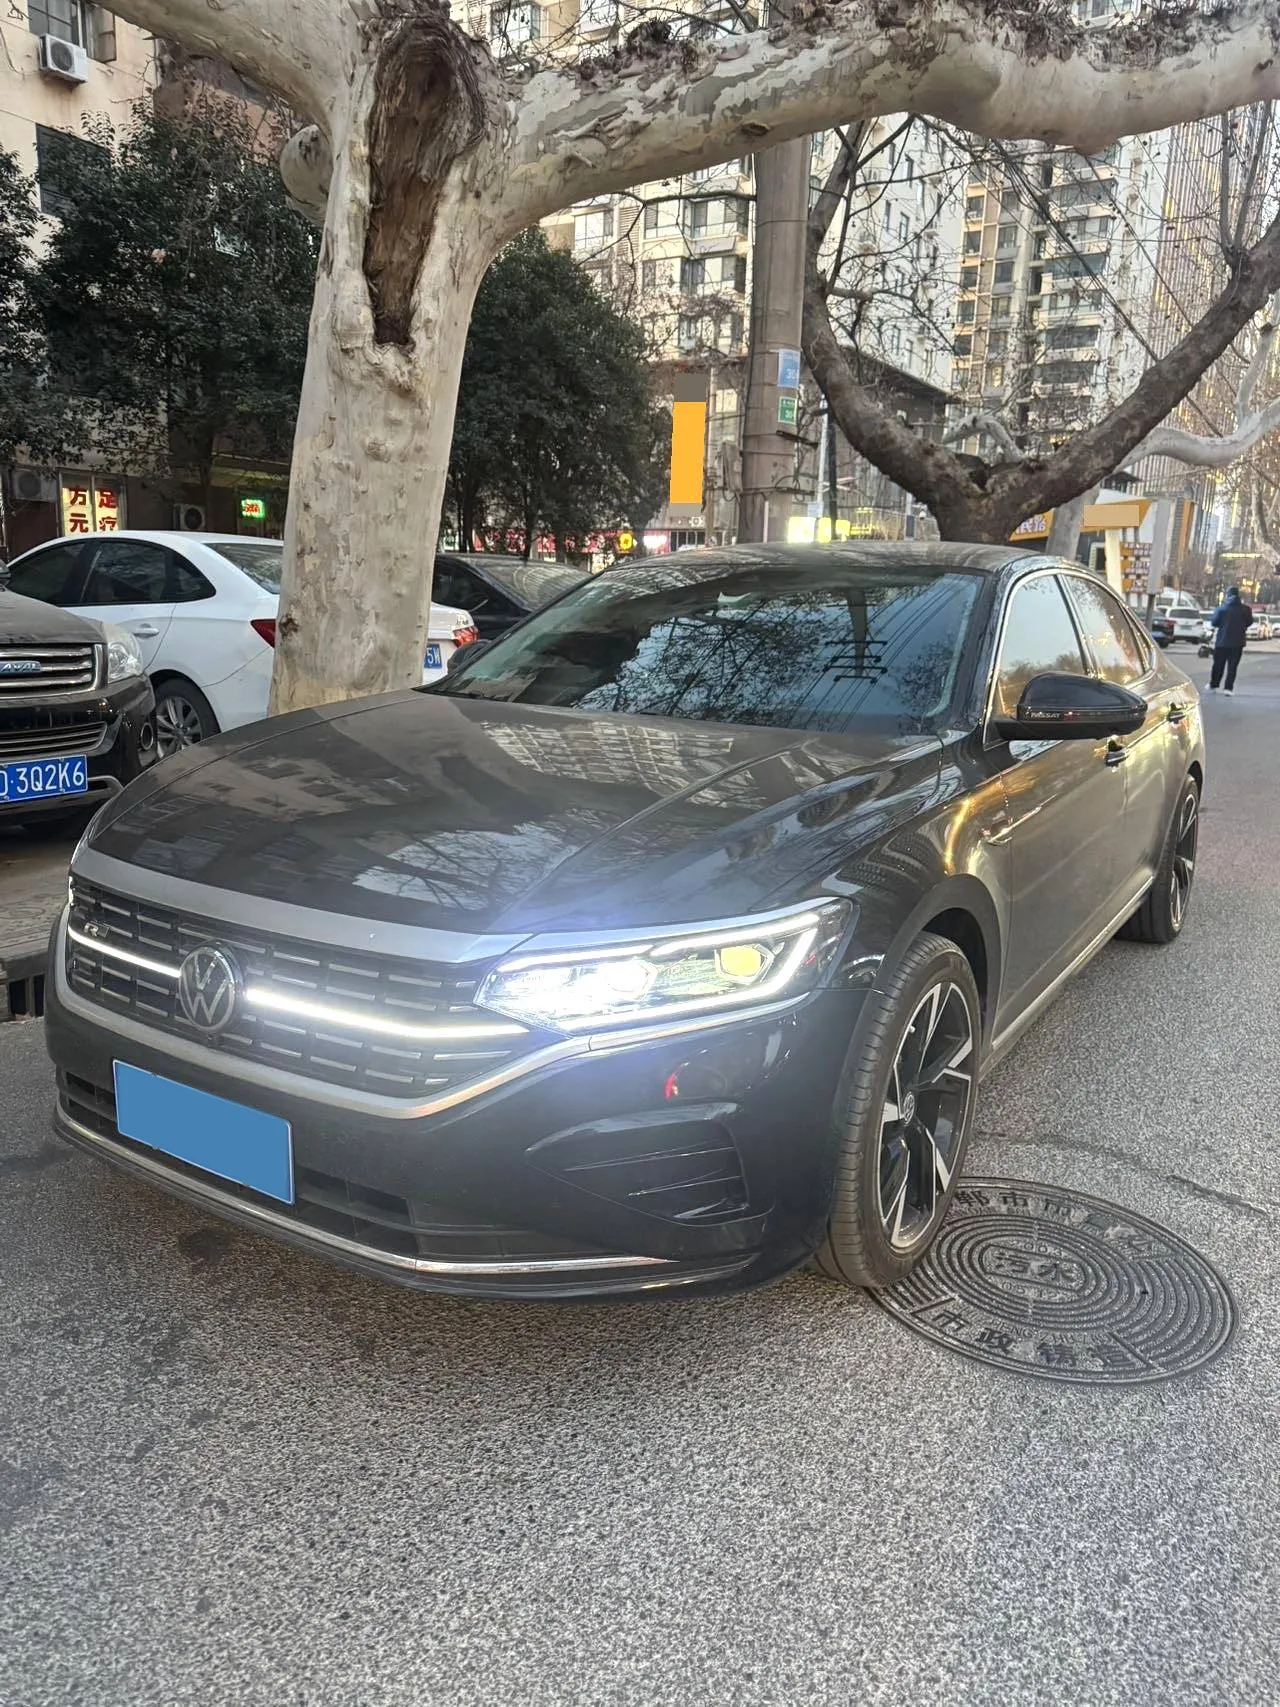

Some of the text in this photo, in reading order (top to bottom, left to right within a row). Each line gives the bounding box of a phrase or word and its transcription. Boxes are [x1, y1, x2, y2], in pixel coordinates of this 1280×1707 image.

[69, 485, 88, 533] 方元
[98, 490, 117, 531] 足疗
[995, 1251, 1077, 1282] 污水
[932, 1310, 1136, 1367] 市政铸造
